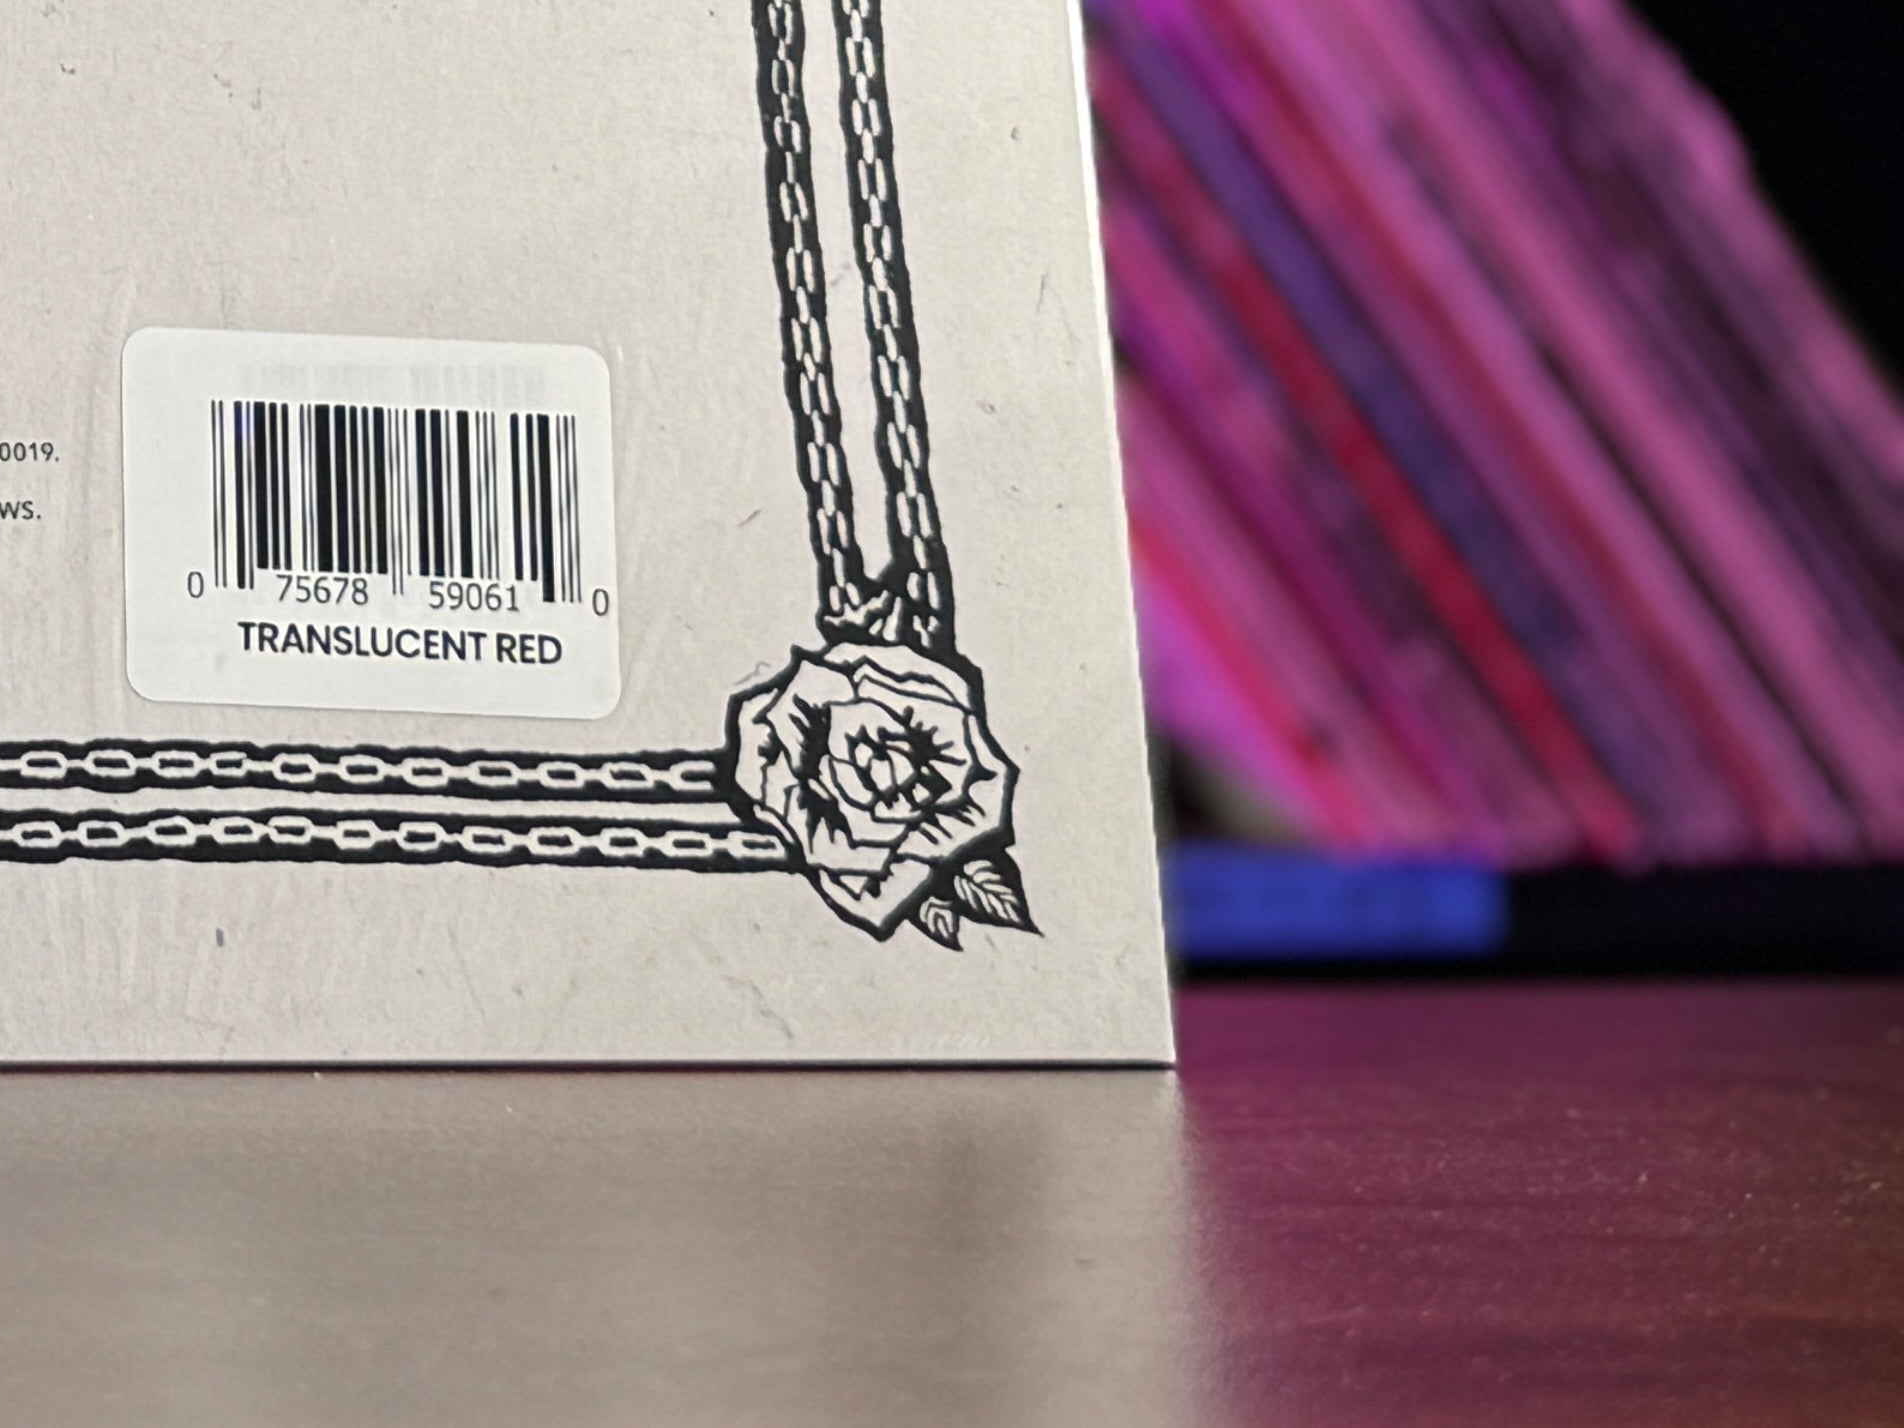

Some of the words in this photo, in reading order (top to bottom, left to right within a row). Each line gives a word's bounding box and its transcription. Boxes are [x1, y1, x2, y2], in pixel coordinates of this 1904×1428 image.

[188, 572, 204, 598] 0
[277, 575, 368, 605] 75678
[430, 581, 519, 612] 59061
[592, 589, 609, 616] 0
[238, 622, 487, 660] TRANSLUCENT
[496, 633, 562, 664] RED
